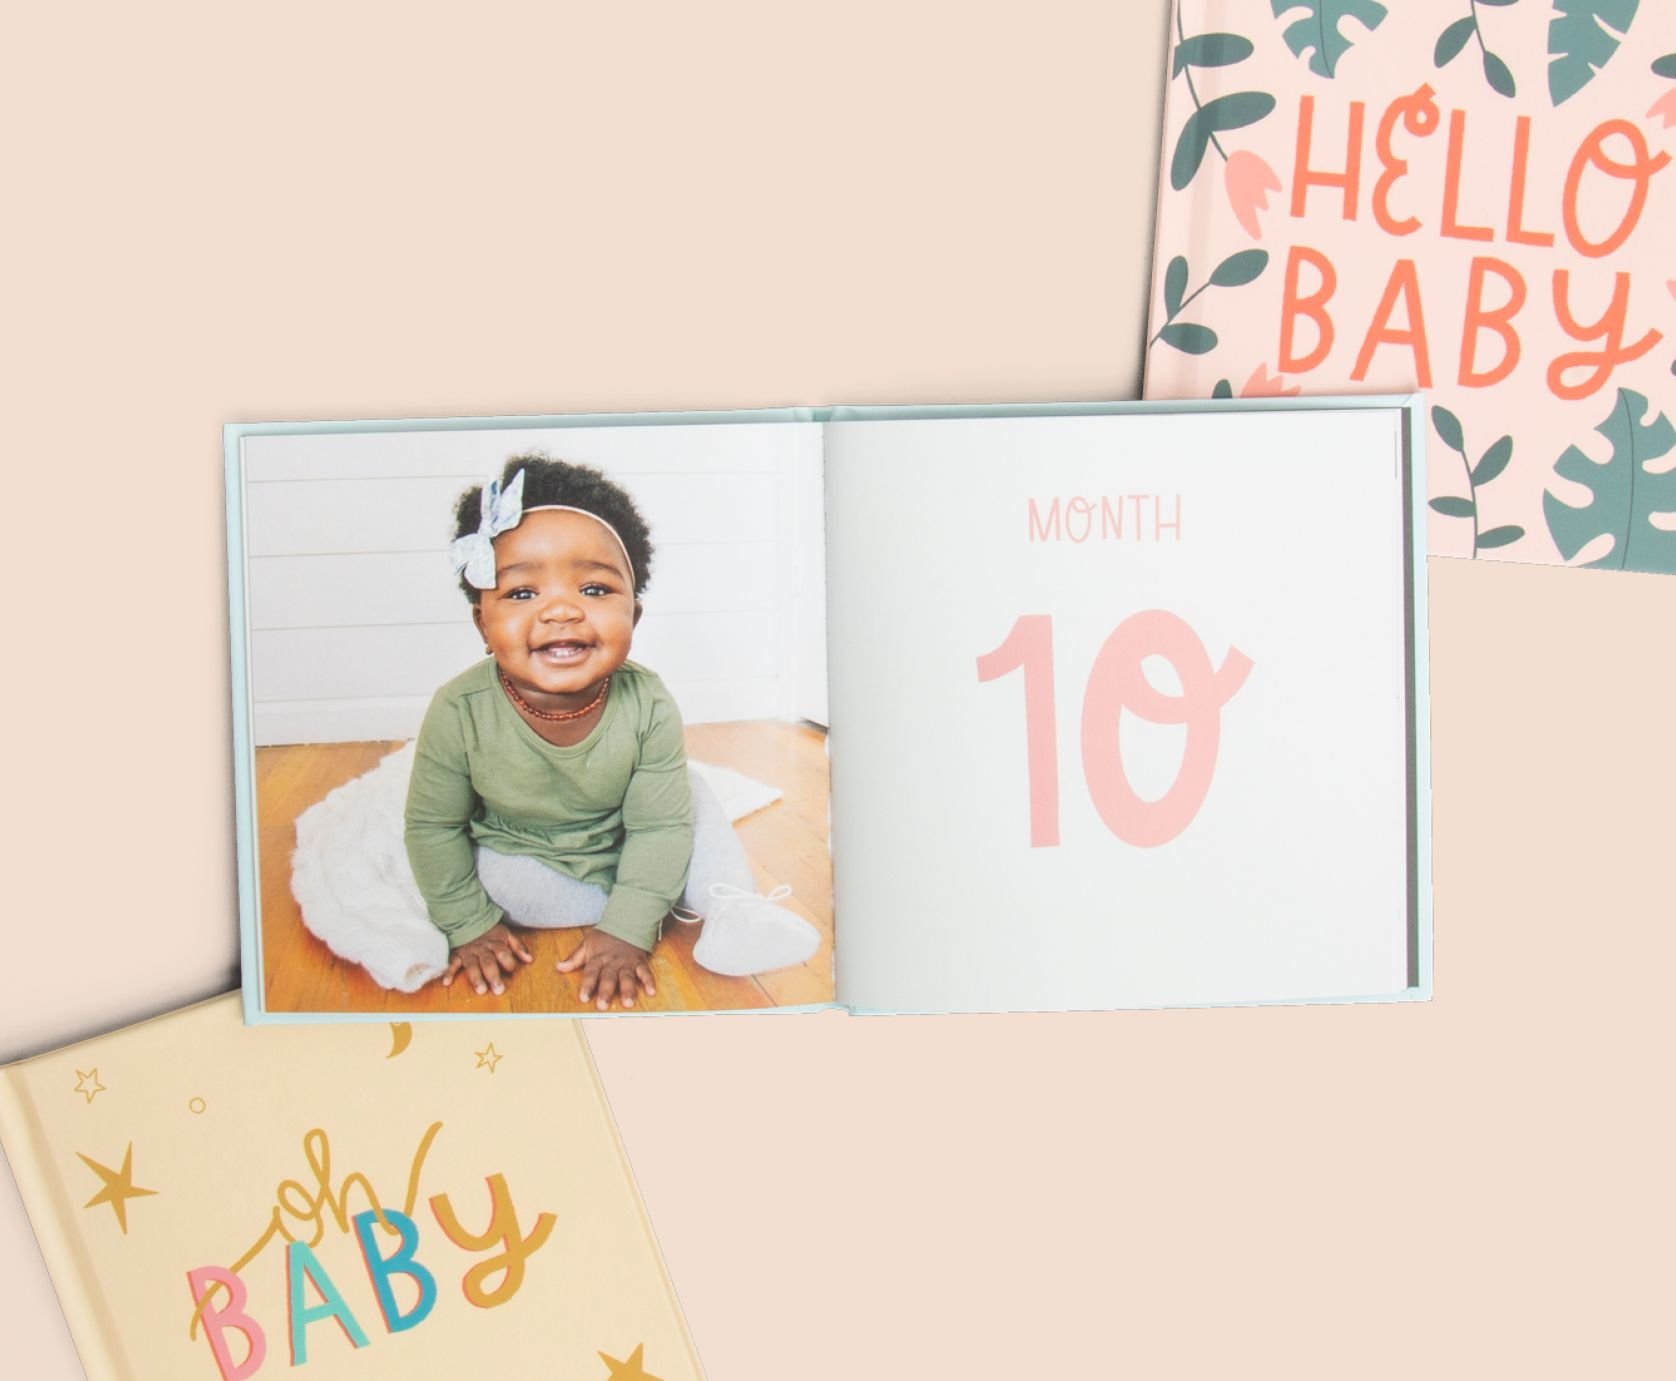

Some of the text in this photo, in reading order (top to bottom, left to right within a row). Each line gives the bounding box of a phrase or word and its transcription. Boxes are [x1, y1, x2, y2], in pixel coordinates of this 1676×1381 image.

[1290, 82, 1672, 258] HELLO
[1278, 245, 1664, 401] BABY
[1027, 494, 1182, 543] MONTH
[976, 609, 1255, 848] 10
[186, 1172, 558, 1381] BABY
